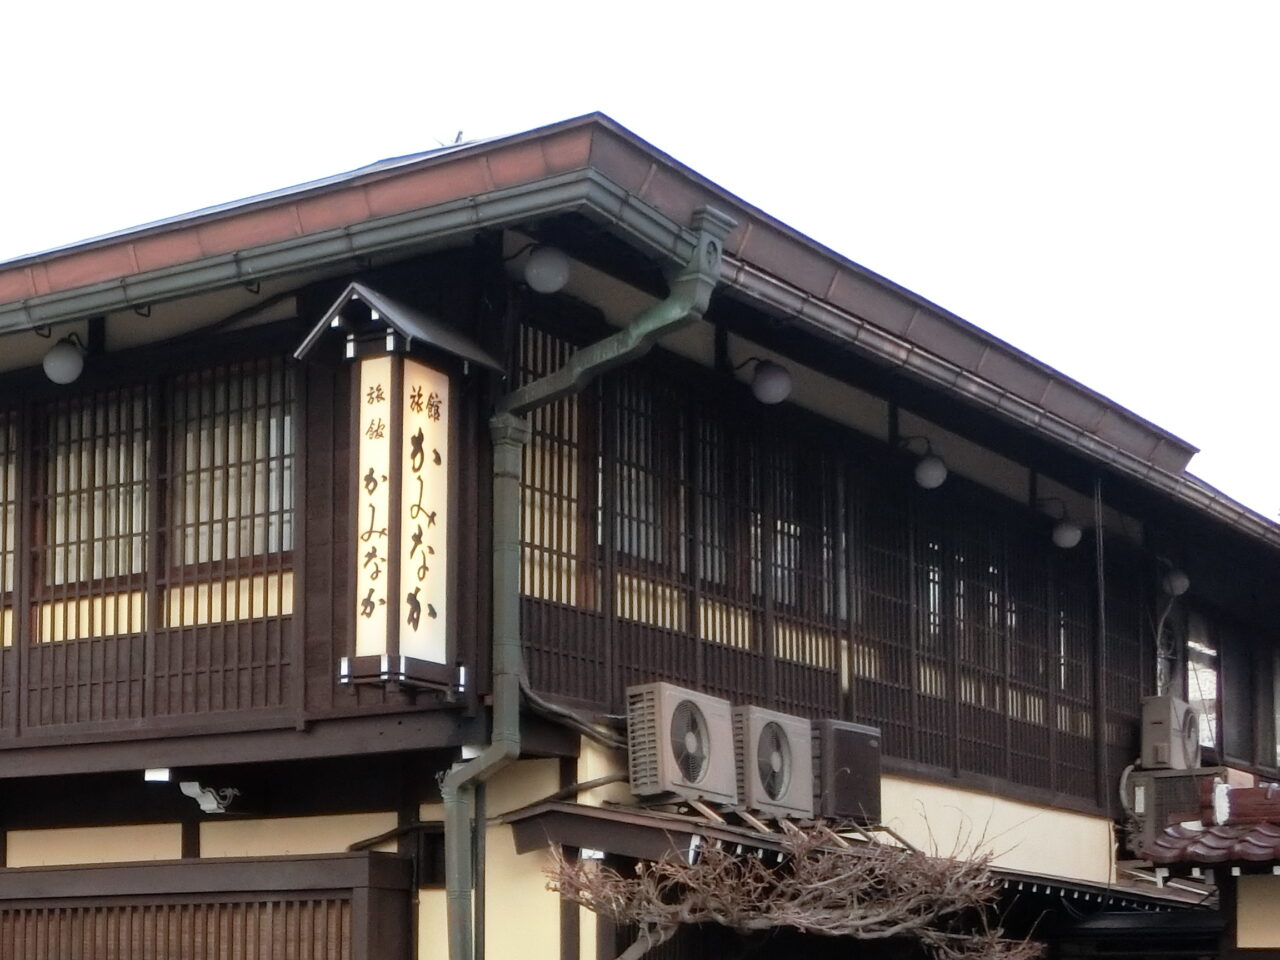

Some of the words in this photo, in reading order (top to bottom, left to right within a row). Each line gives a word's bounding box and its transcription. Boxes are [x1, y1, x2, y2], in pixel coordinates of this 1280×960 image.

[409, 385, 443, 422] 旅館
[360, 467, 388, 619] かみなか
[406, 426, 442, 632] かみなか
